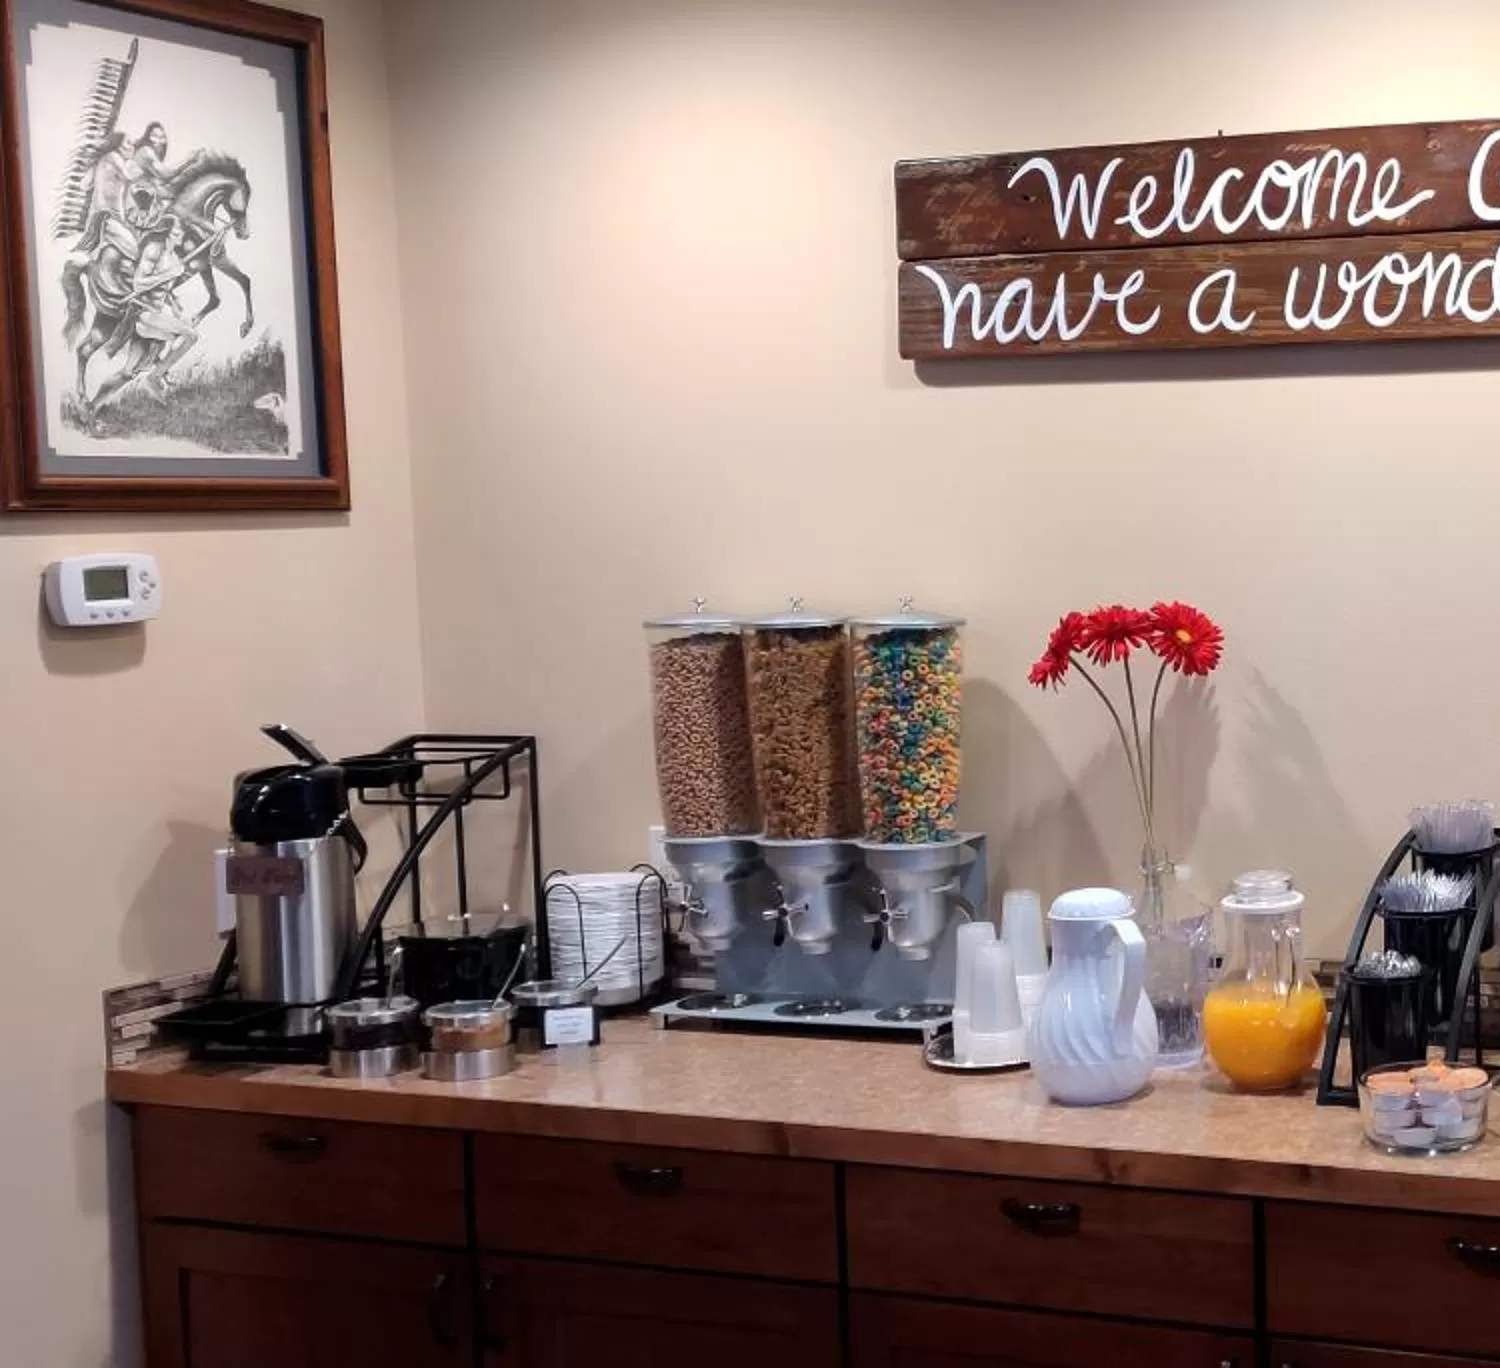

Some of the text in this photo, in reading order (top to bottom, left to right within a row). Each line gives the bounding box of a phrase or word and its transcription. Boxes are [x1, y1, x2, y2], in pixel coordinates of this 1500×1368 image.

[1007, 147, 1435, 240] Welcome
[914, 264, 1160, 349] have
[1187, 269, 1256, 333] a
